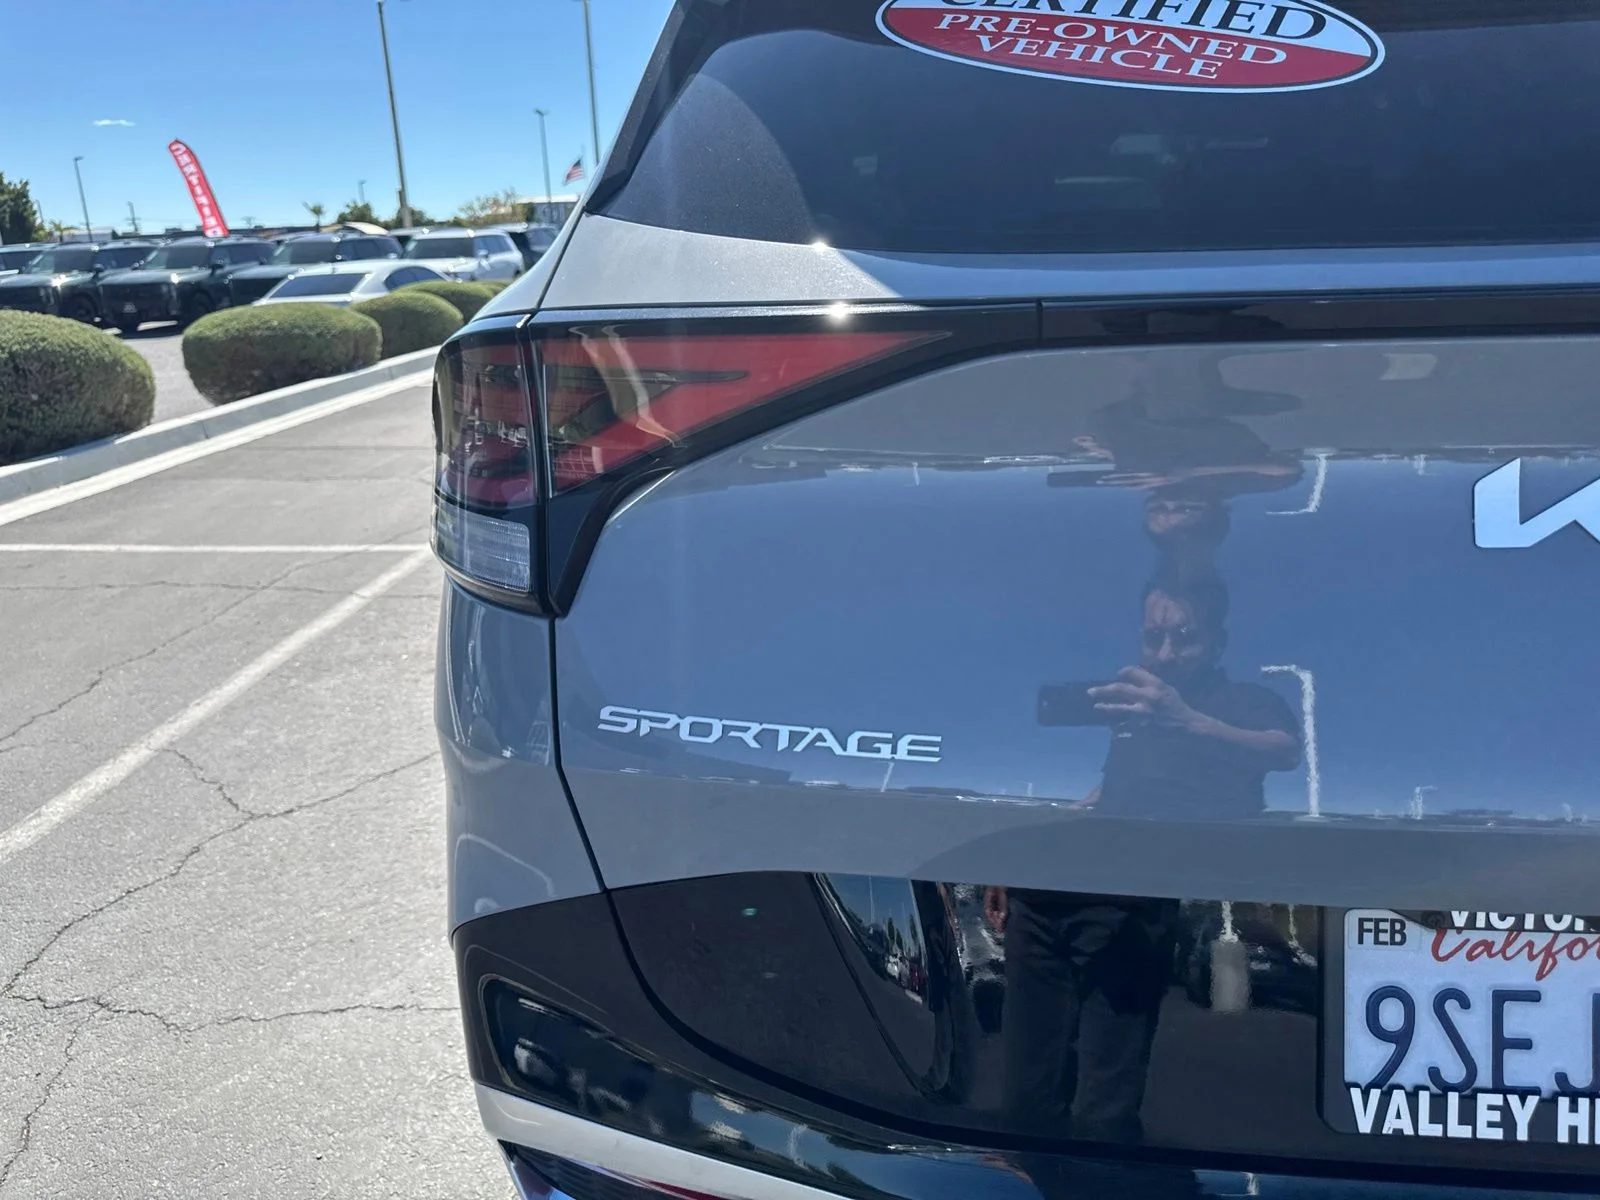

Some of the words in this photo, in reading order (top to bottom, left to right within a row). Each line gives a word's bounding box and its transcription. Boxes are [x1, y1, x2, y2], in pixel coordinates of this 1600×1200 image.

[934, 13, 1287, 65] PRE-OWNED
[938, 0, 1326, 39] IFIED
[976, 34, 1223, 80] VEHICLE
[597, 705, 942, 762] SPORTAGE
[1357, 917, 1408, 947] FEB
[1431, 928, 1600, 982] Califo
[1350, 1086, 1540, 1142] VALLEY
